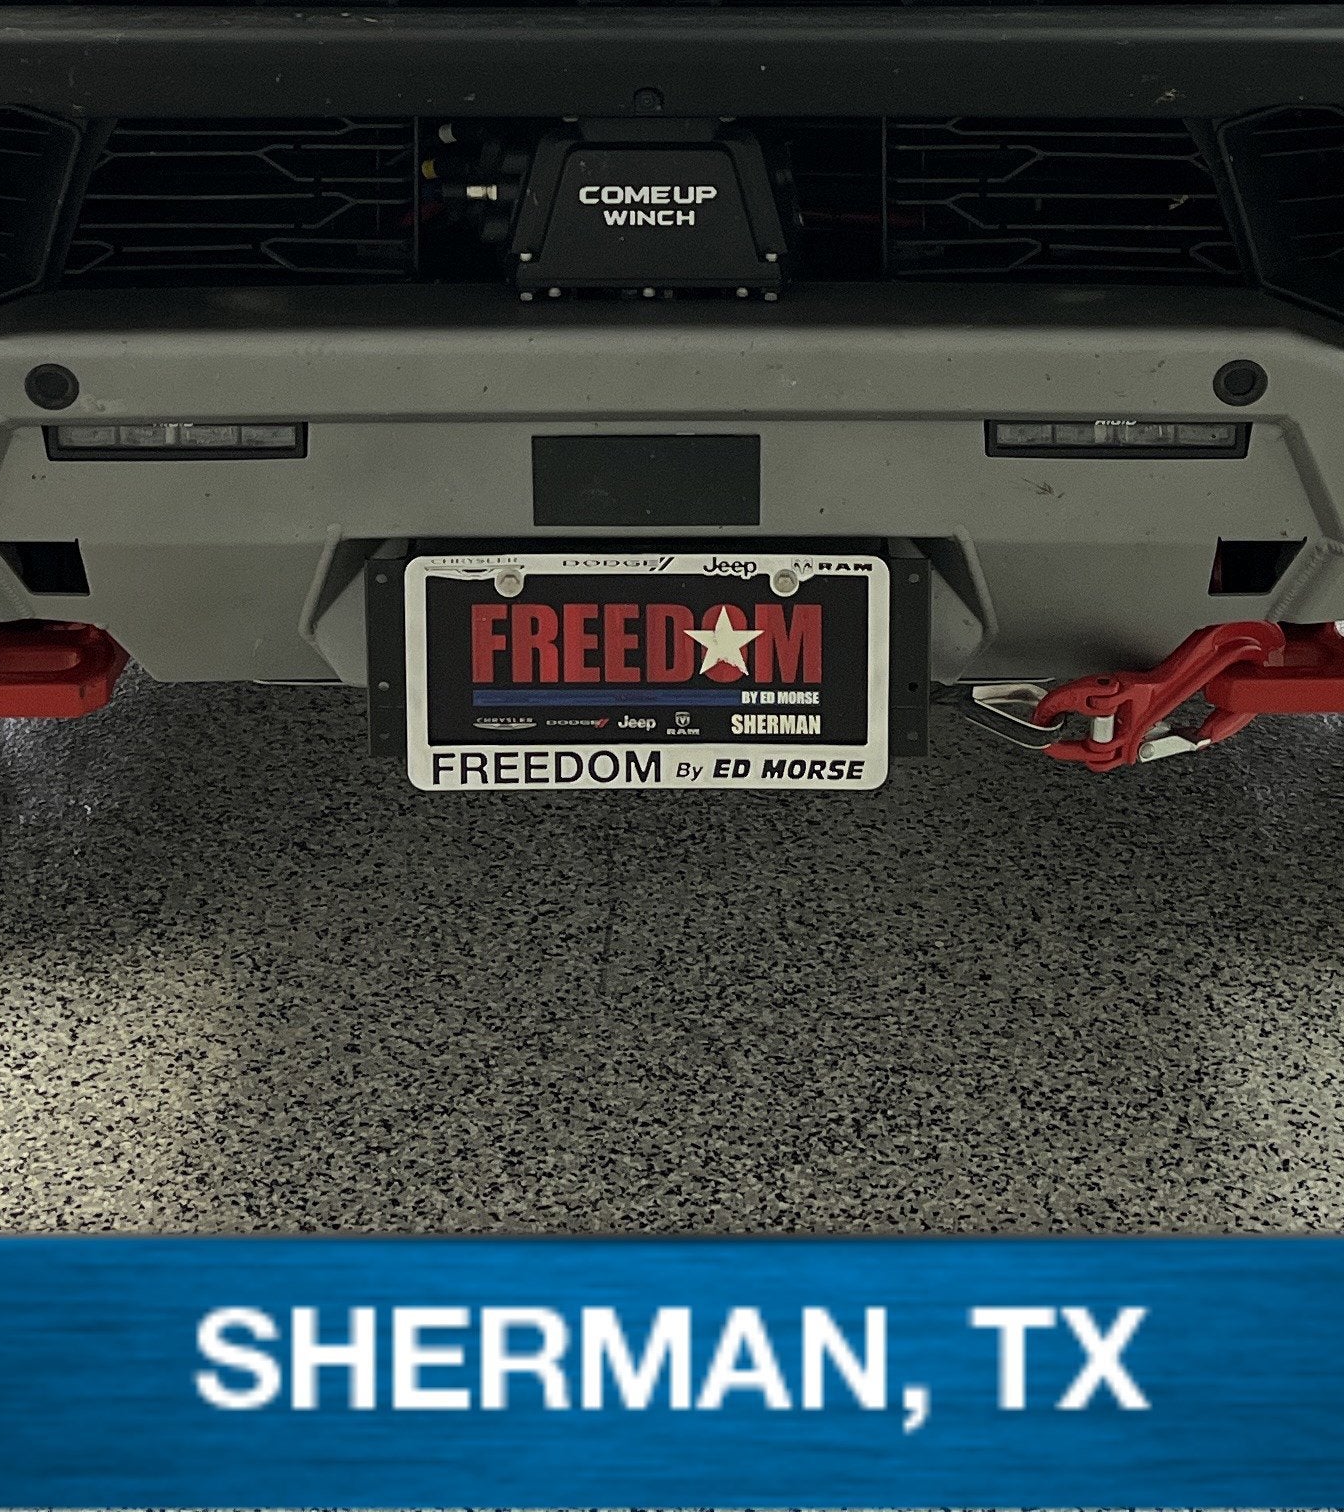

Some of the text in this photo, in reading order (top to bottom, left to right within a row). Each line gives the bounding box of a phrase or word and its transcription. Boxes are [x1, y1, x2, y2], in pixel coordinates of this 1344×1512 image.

[578, 185, 718, 205] COMEUP
[603, 210, 696, 226] WINCH
[703, 557, 757, 576] Jeep
[818, 562, 873, 571] RAM
[471, 603, 823, 684] FREEDOM
[741, 691, 820, 705] BY ED MORSE
[617, 715, 657, 731] Jeep
[731, 713, 821, 735] SHERMAN
[432, 750, 866, 785] FREEDOM By ED MORSE
